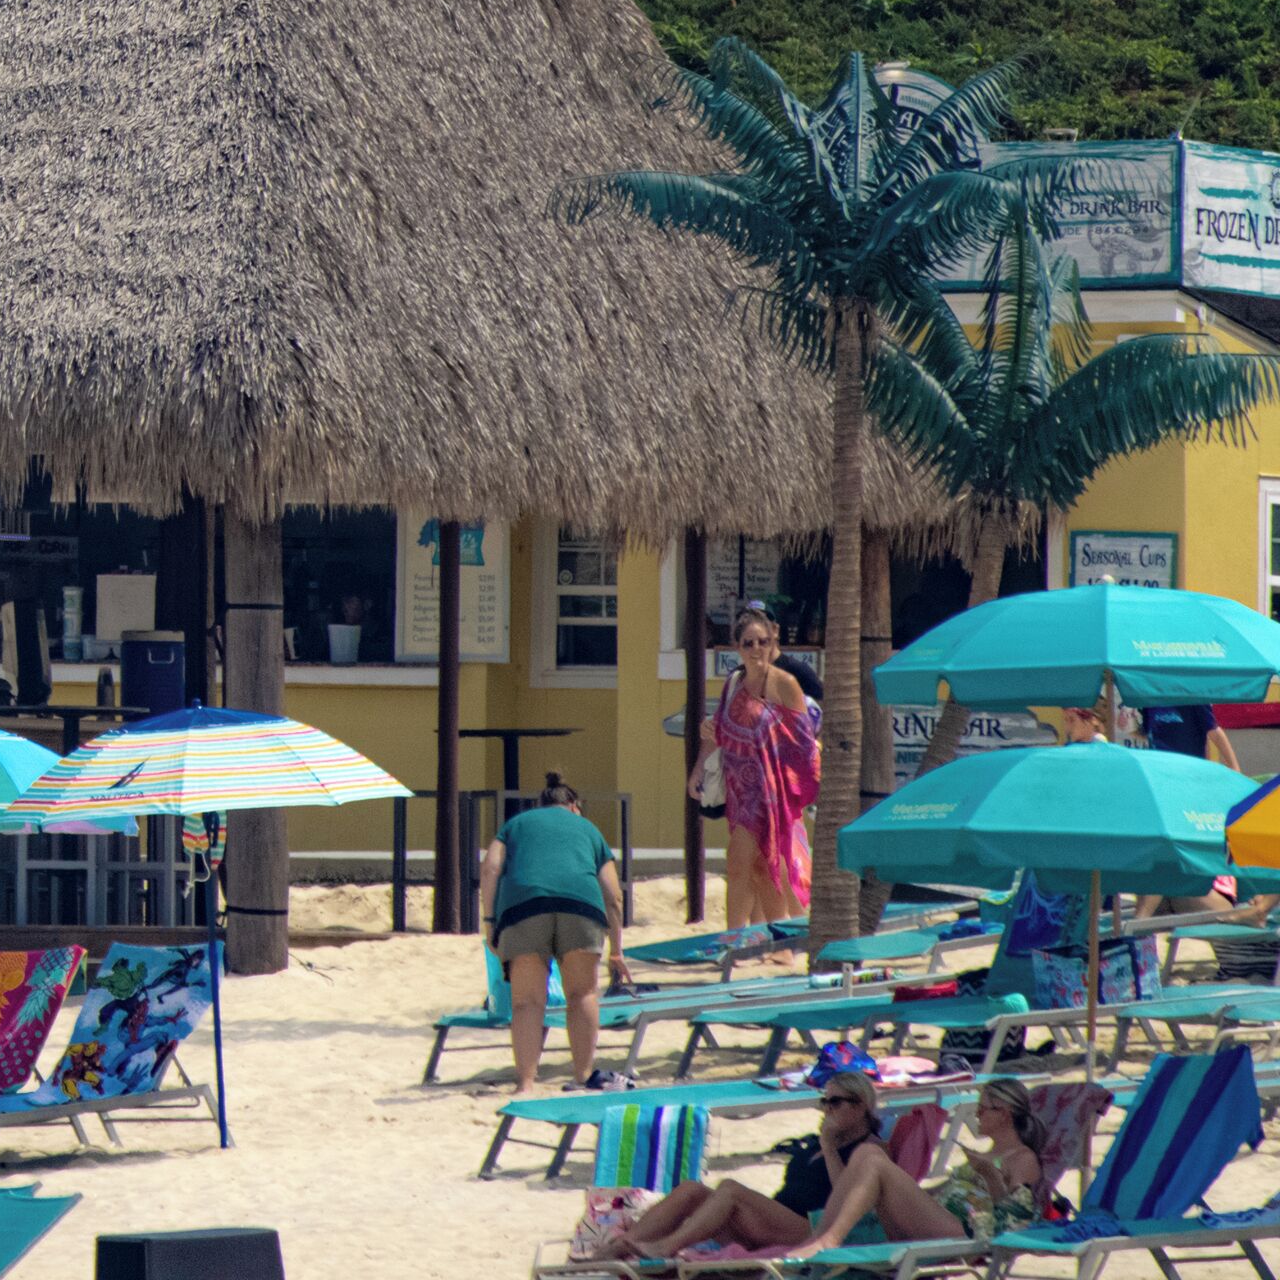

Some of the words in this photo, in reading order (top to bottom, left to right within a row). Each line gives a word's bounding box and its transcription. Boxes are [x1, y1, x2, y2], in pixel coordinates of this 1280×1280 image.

[1070, 199, 1125, 218] DRINK
[1127, 199, 1168, 216] BAR
[1195, 207, 1262, 252] FROZEN
[1081, 542, 1132, 568] SEASONAL
[1139, 544, 1167, 568] CUPS
[89, 790, 145, 802] NAUTICA
